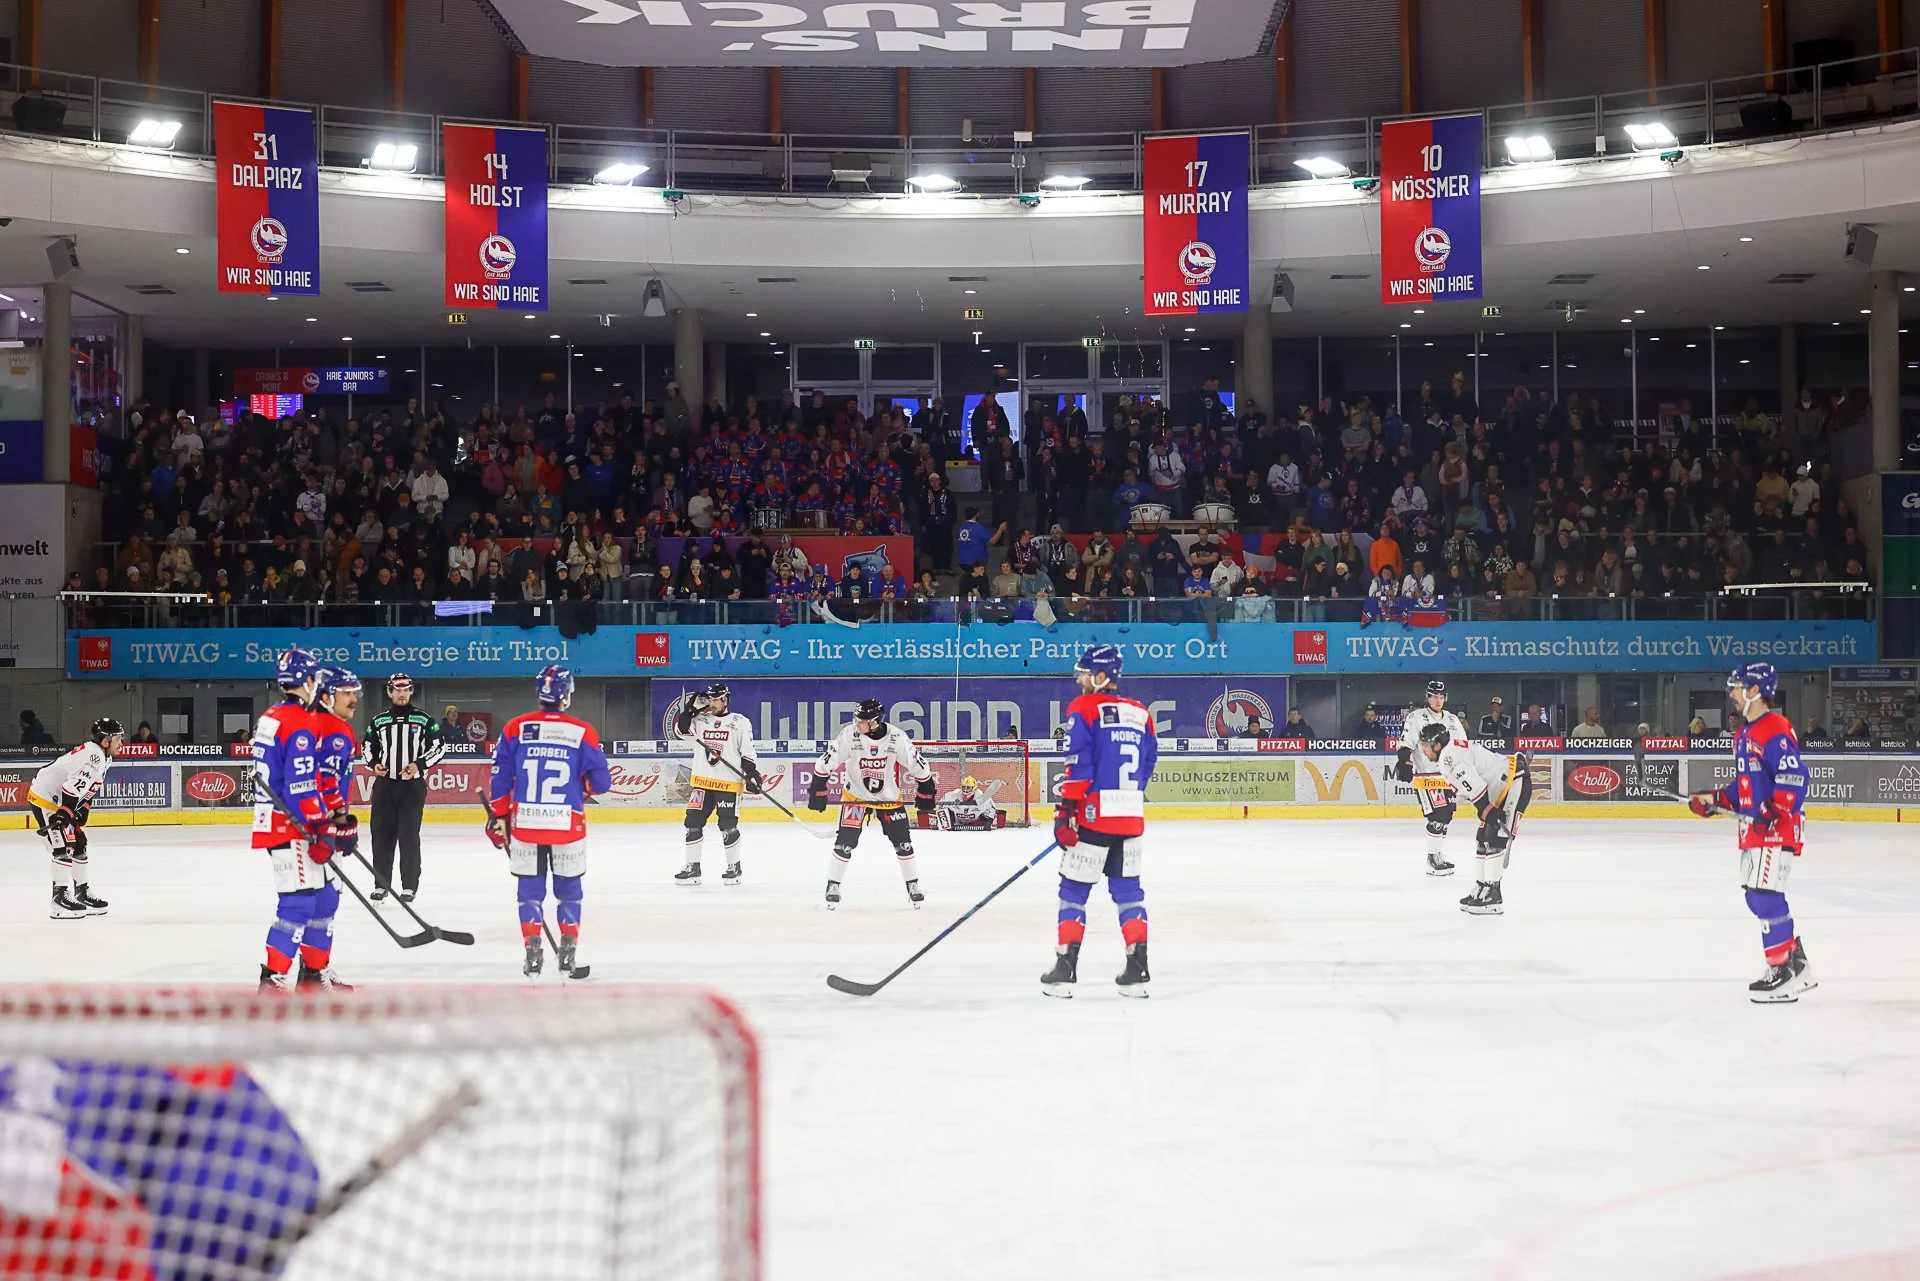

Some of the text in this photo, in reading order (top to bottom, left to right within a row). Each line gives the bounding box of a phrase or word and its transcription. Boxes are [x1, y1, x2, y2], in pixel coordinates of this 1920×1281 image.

[253, 132, 278, 161] 31
[483, 153, 508, 180] 14
[1420, 144, 1443, 172] 10
[233, 164, 302, 190] DALPIAZ
[1184, 161, 1208, 188] 17
[470, 184, 523, 208] HOLST
[1391, 174, 1469, 202] MÖSSMER
[1159, 191, 1232, 216] MURRAY
[226, 268, 311, 287] WIR SIND HAIE
[1390, 275, 1474, 295] WIR SIND HAIE
[454, 283, 539, 303] WIR SIND HAIE
[1153, 289, 1241, 308] WIR SIND HAIE
[326, 371, 342, 381] HAIE
[344, 371, 374, 381] JUNIORS
[343, 382, 357, 391] BAR
[131, 643, 219, 664] TIWAG
[246, 642, 350, 663] Saere
[358, 641, 459, 668] Energie
[468, 640, 503, 662] für
[509, 640, 568, 662] Tirol
[688, 639, 781, 660] TIWAG
[807, 639, 845, 660] Ihr
[852, 637, 1021, 660] verlässlicher
[1134, 642, 1176, 659] vor
[1185, 638, 1228, 660] Ort
[1346, 636, 1439, 658] TIWAG
[1465, 636, 1619, 657] Klimaschutz
[1627, 636, 1701, 656] durch
[1706, 634, 1857, 656] Wasserkraft
[638, 656, 666, 664] TIWAG
[1296, 653, 1325, 662] TIWAG
[1209, 694, 1268, 734] TIROLER WASSERKRAFT
[160, 745, 222, 755] HOCHZEIGER
[1260, 740, 1376, 750] PITZTAL HOCHZEIGER
[1518, 739, 1560, 749] PITZTAL
[1566, 738, 1632, 748] HOCHZEIGER
[1646, 739, 1684, 748] PITZTAL
[1806, 740, 1834, 748] lichtblick
[1845, 740, 1871, 748] lichtblick
[1880, 740, 1906, 748] lichtblick
[527, 747, 570, 760] CORBEIL
[294, 756, 314, 776] 53
[1118, 744, 1140, 791] 2
[1626, 764, 1674, 775] FARPLAY
[1778, 755, 1798, 776] 60
[74, 778, 86, 792] 12
[200, 774, 228, 794] holly
[522, 760, 571, 804] 12
[1152, 772, 1290, 783] BILDUNGSZENTRUM
[1462, 780, 1472, 792] 9
[1583, 771, 1612, 790] holly
[1626, 776, 1638, 785] ist
[106, 782, 166, 797] HOLLAUS BAU
[1182, 787, 1260, 796] www.awut.at
[718, 800, 735, 808] vkw
